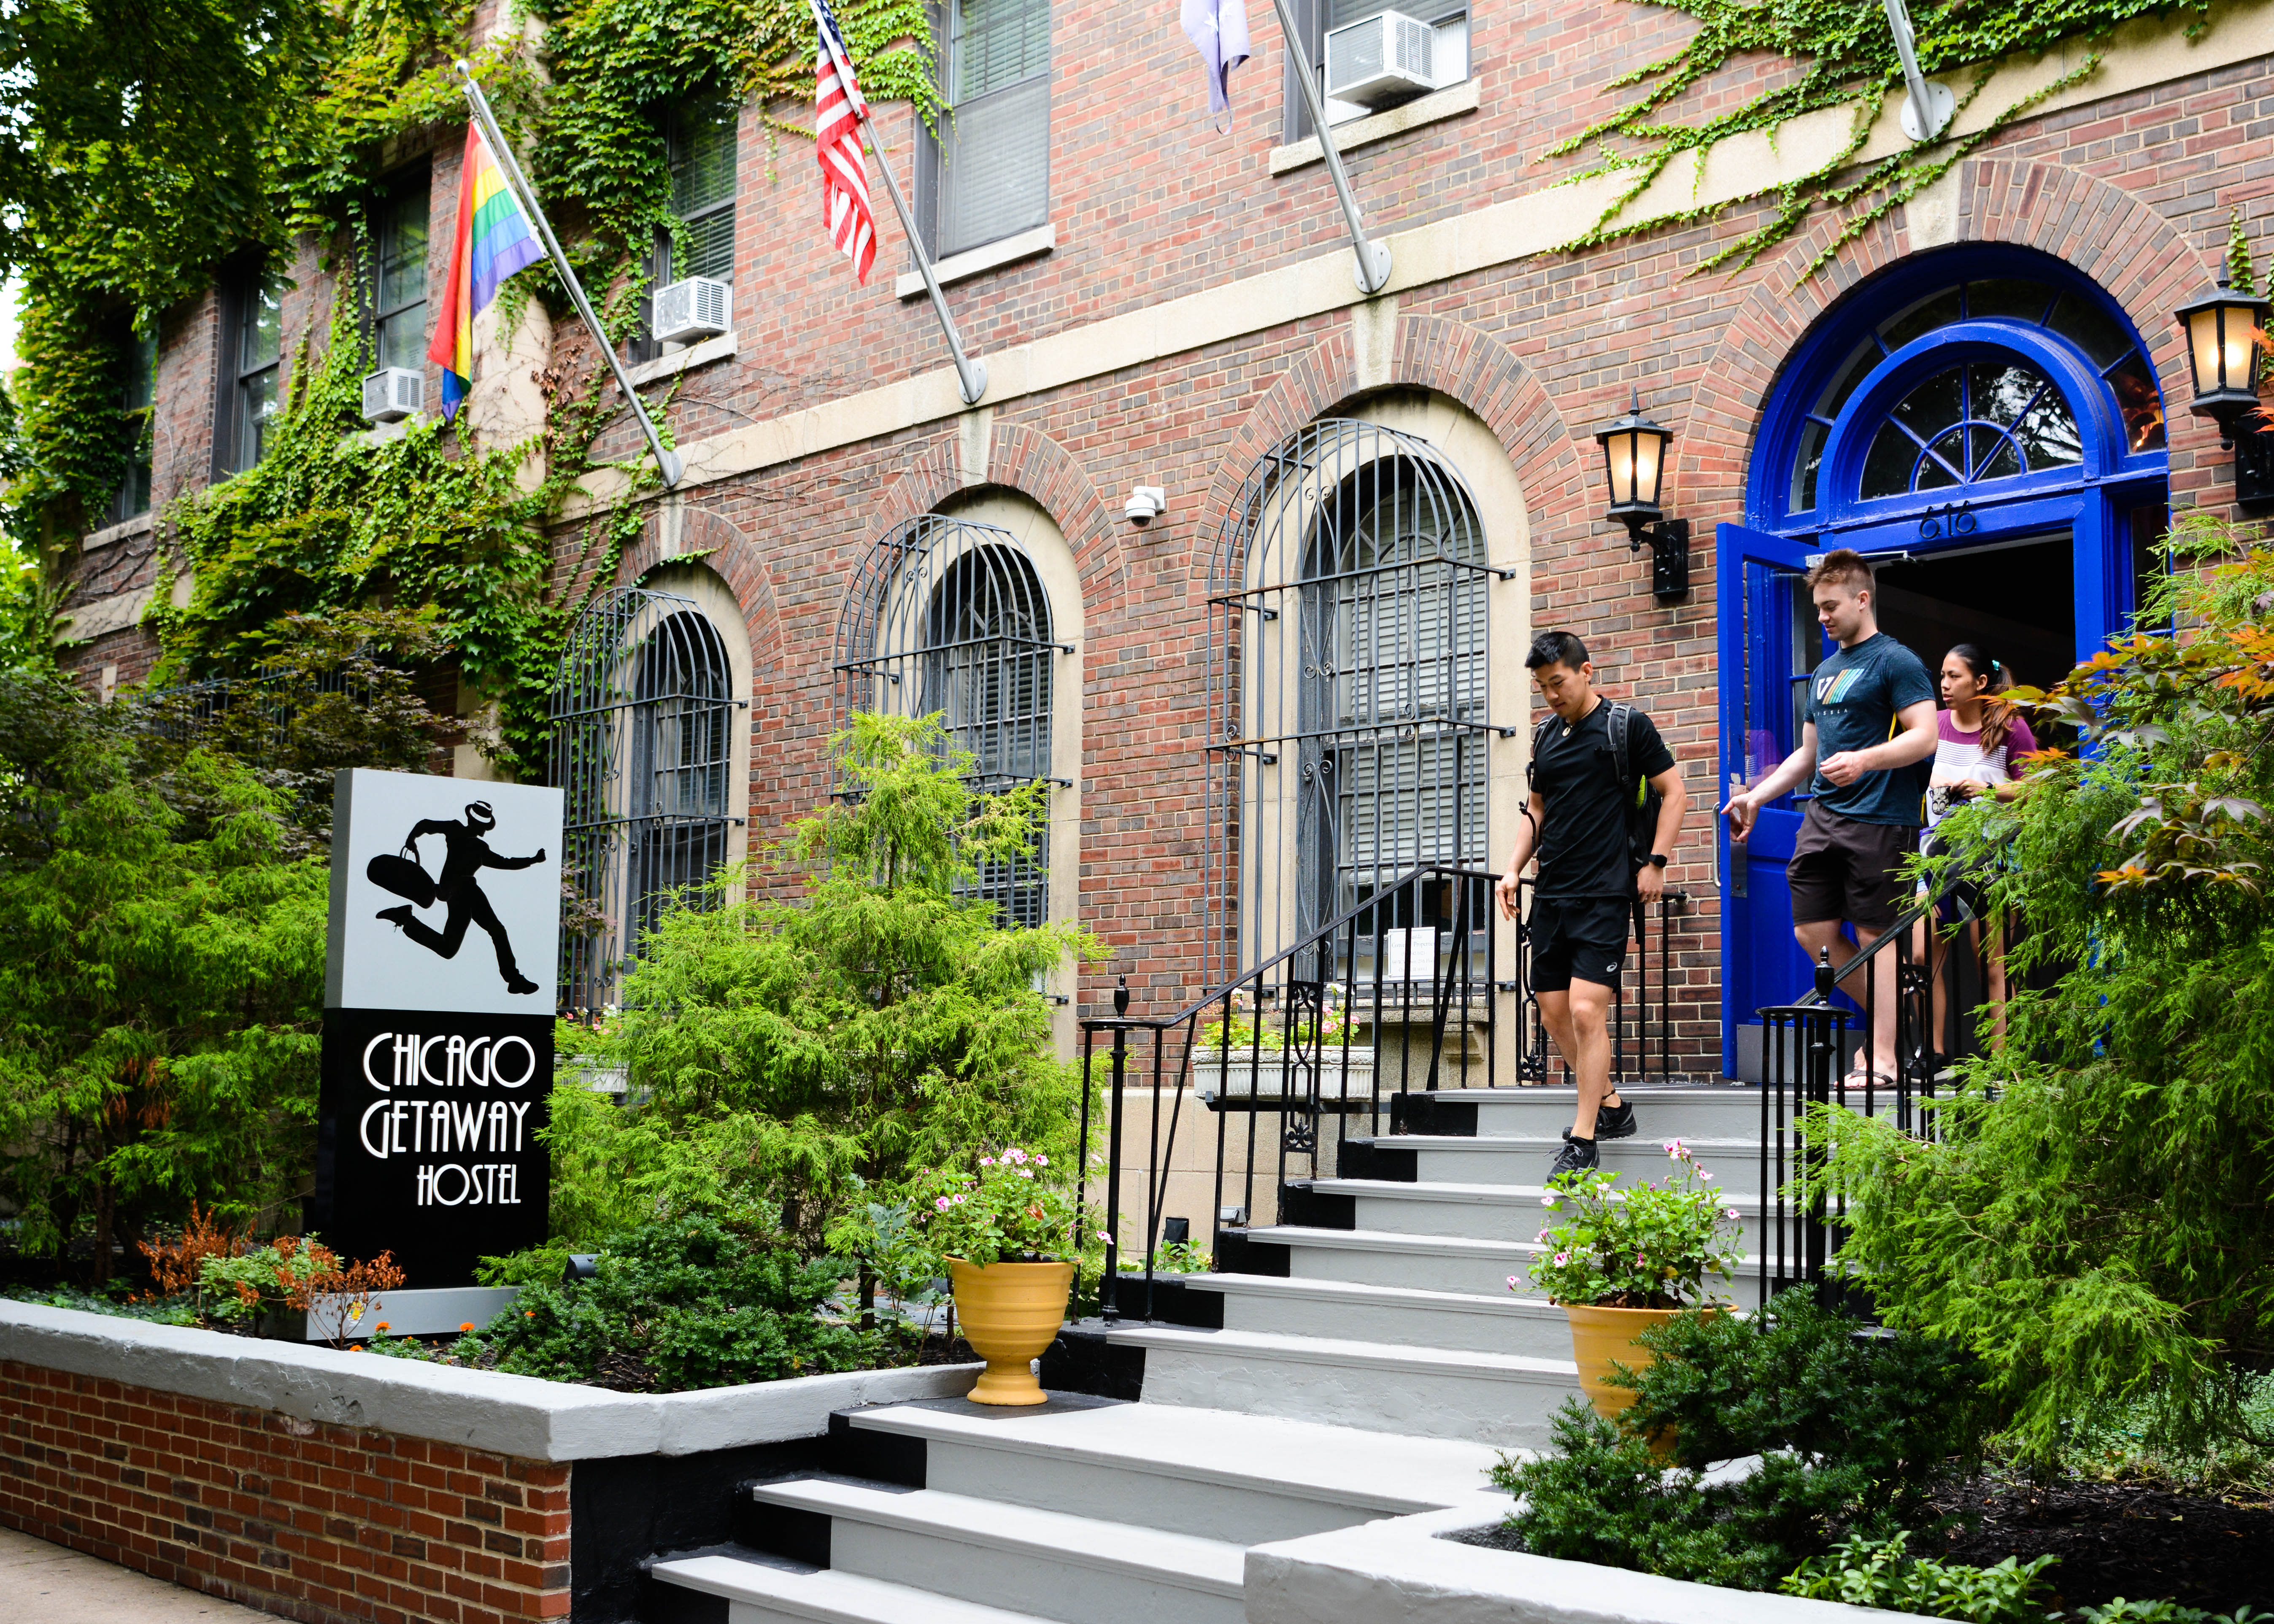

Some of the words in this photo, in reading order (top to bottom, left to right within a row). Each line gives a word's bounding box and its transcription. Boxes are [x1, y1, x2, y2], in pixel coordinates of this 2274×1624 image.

[1920, 500, 1977, 539] 616
[363, 1033, 535, 1091] CHICAGO
[360, 1099, 531, 1158] GETAWAY
[417, 1164, 521, 1206] HOSTEL
